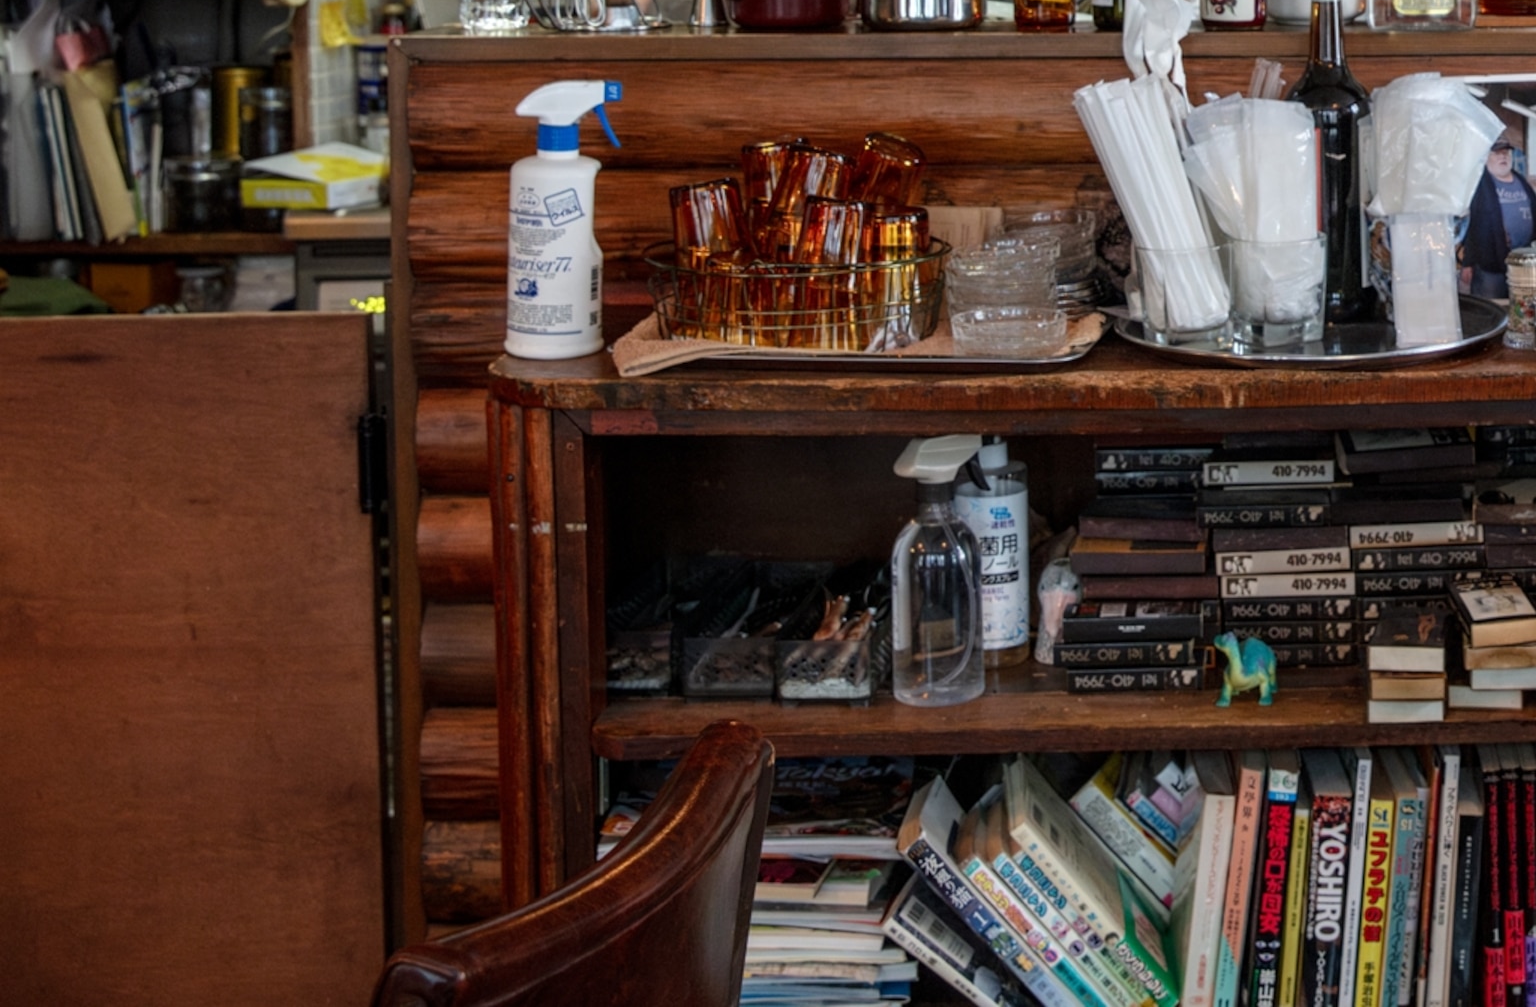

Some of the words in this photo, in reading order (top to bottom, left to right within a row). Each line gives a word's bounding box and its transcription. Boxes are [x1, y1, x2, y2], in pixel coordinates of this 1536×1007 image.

[1272, 465, 1326, 477] 410-7994
[1359, 530, 1414, 543] 410-7994
[979, 534, 1018, 557] 菌用
[983, 556, 1019, 572] ノール
[1287, 552, 1343, 566] 410-7994
[1419, 552, 1478, 565] 410-7994
[1292, 578, 1347, 590] 410-7994
[1364, 579, 1421, 591] 410-7994
[1232, 604, 1291, 617] 410-7994
[1060, 649, 1121, 662] 410-7994
[1074, 674, 1135, 688] 410-7994
[1314, 822, 1348, 942] YOSHIRO
[972, 911, 989, 926] 1
